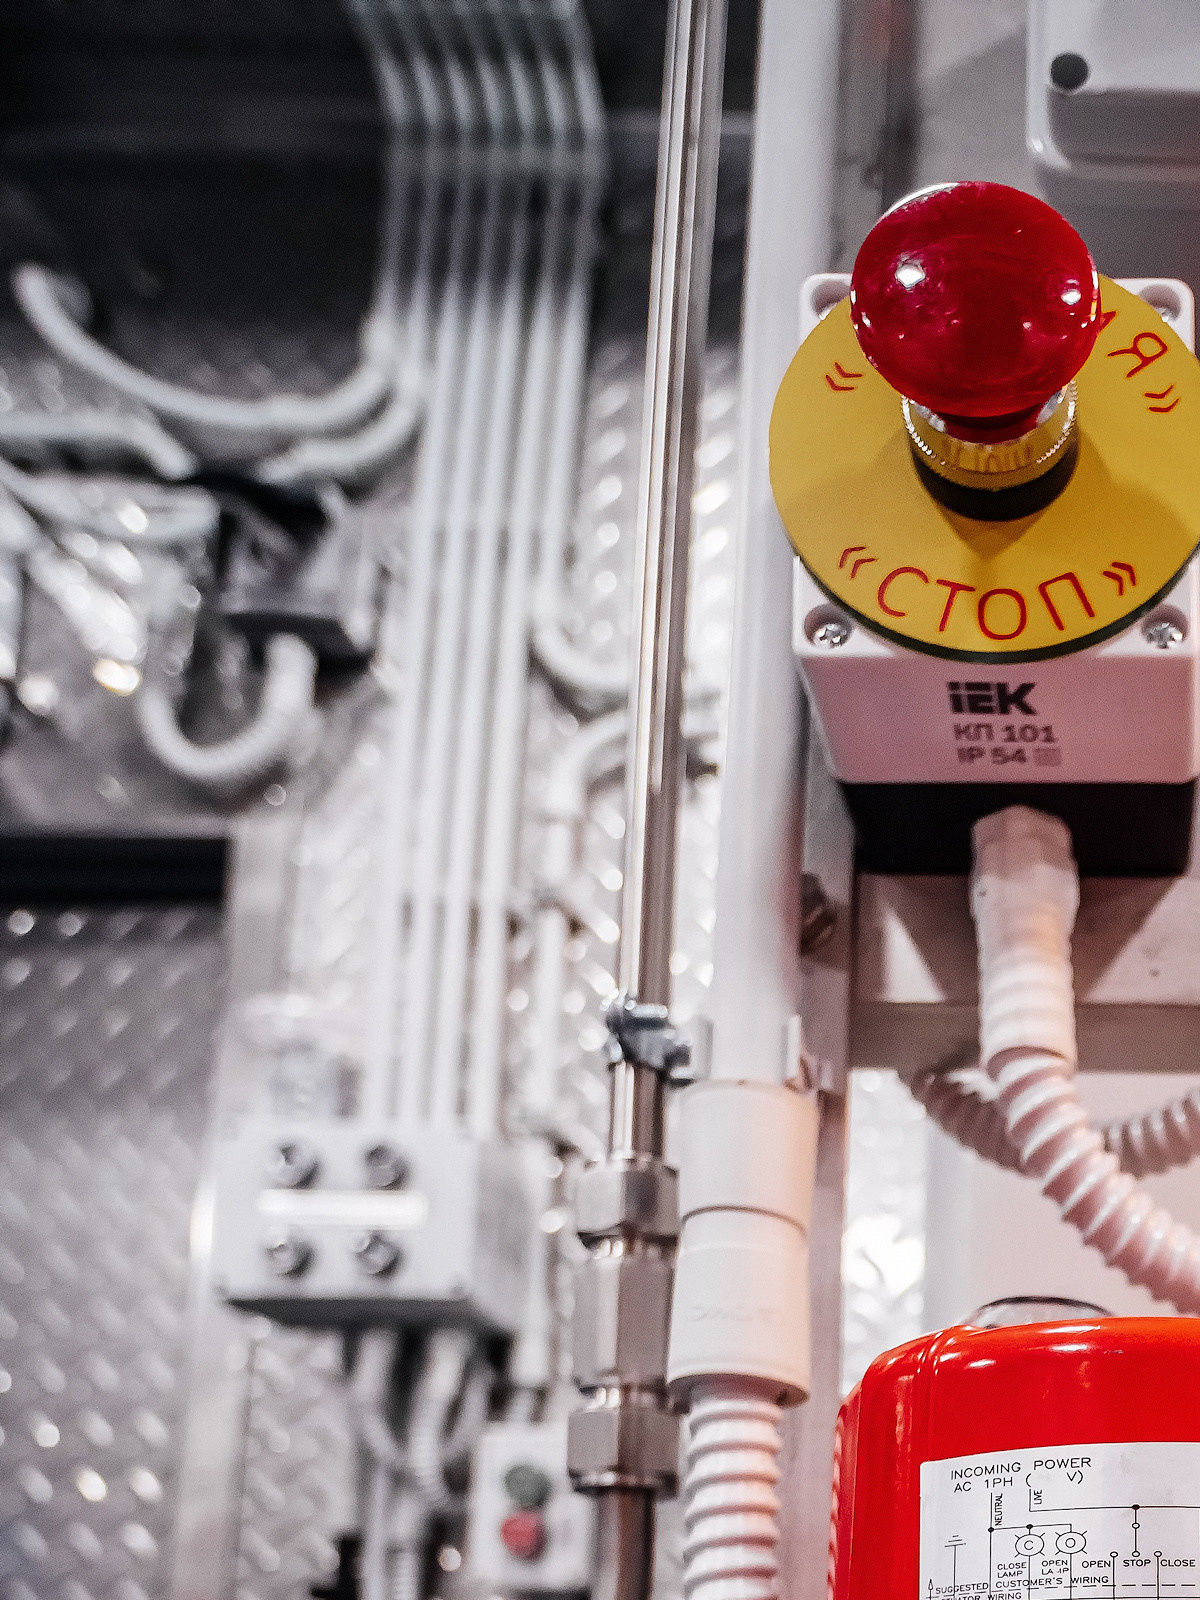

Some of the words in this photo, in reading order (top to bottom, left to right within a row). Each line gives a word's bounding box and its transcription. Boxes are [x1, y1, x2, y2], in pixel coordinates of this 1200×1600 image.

[1003, 724, 1057, 742] 101
[957, 746, 985, 764] IP
[991, 747, 1027, 765] 54
[951, 1462, 1021, 1480] INCOMING
[1034, 1457, 1092, 1470] POWER
[954, 1482, 971, 1493] AC
[985, 1477, 1013, 1488] 1PH
[1034, 1489, 1043, 1505] LIVE
[995, 1493, 1003, 1526] NEUTRAL
[1024, 1540, 1034, 1550] C
[997, 1562, 1027, 1571] CLOSE
[1082, 1560, 1111, 1568] OPEN
[1160, 1559, 1196, 1567] CLOSE
[997, 1570, 1024, 1578] LAMP
[935, 1583, 989, 1595] SUGGESTED
[995, 1577, 1063, 1589] CUSTOMER'S
[1071, 1576, 1109, 1584] WIRING
[987, 1592, 1022, 1600] WIRING
